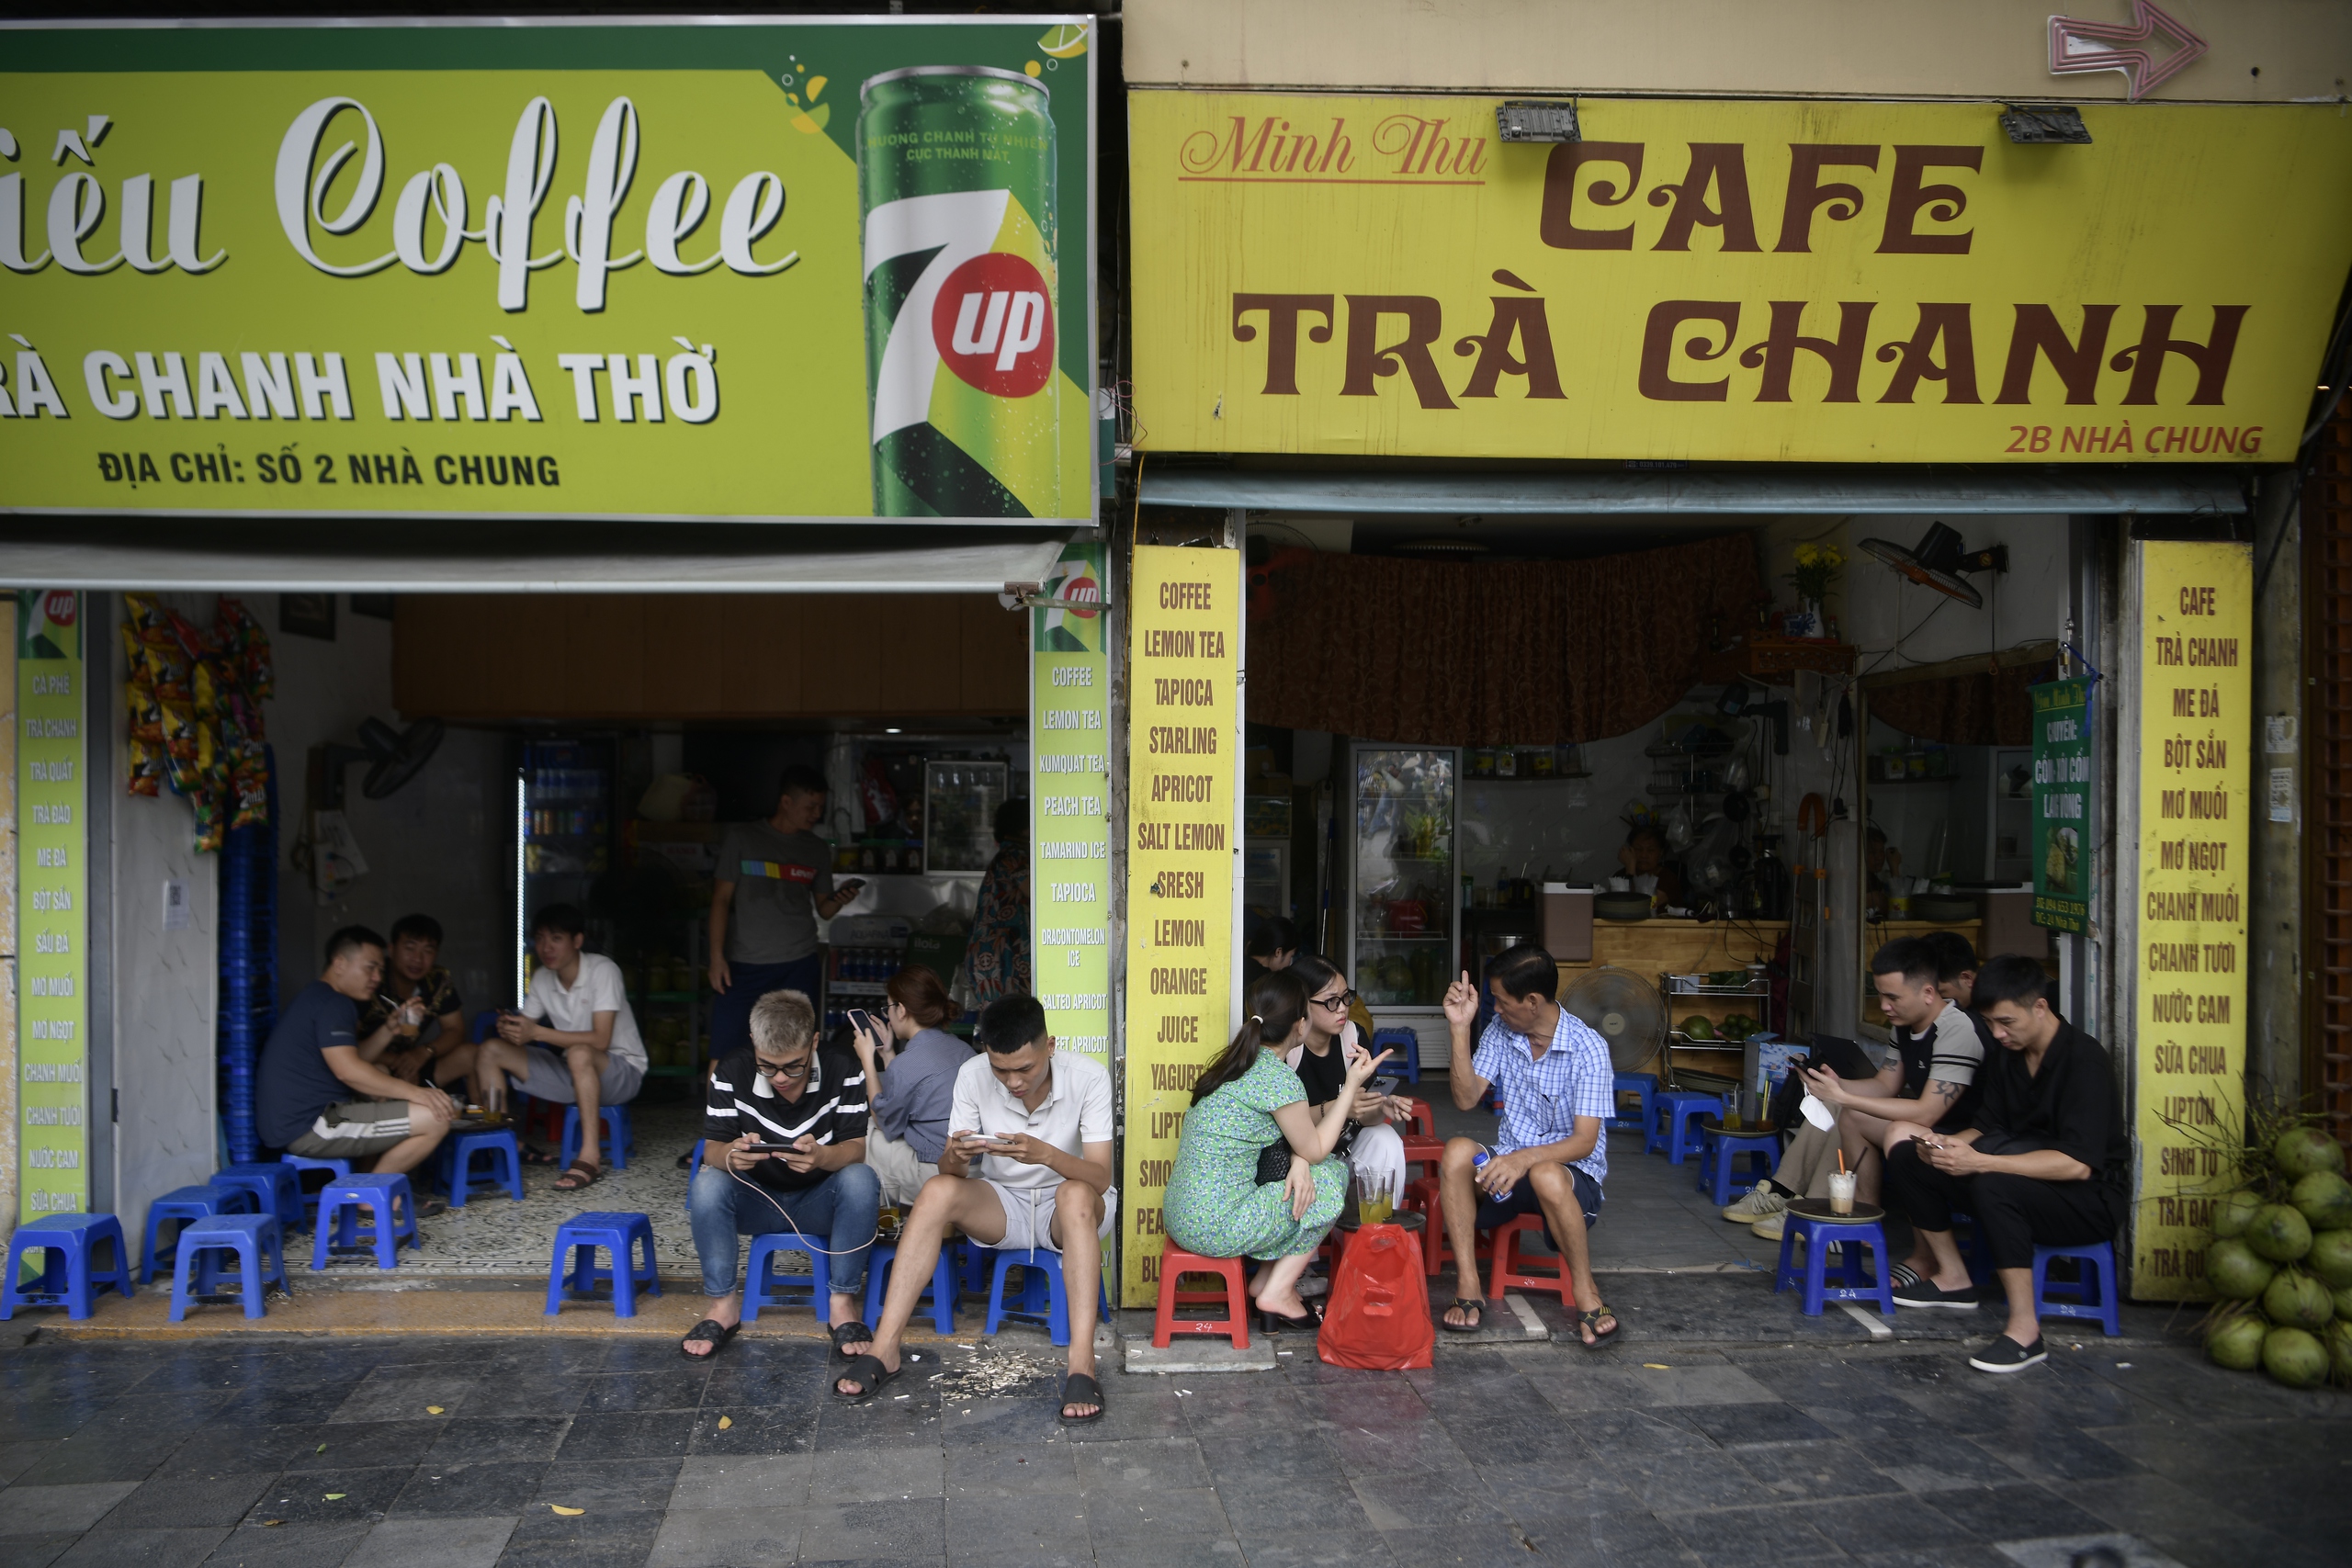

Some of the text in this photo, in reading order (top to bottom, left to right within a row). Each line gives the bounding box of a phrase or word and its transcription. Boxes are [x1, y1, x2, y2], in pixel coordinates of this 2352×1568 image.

[923, 130, 975, 143] CHANH
[1180, 114, 1487, 175] Minh Thu
[275, 96, 801, 313] Coffee
[1539, 141, 1984, 254] CAFE
[953, 290, 1046, 371] up
[1232, 267, 2252, 410] TRÀ CHANH
[83, 350, 355, 422] CHANH
[376, 334, 541, 423] NHÀ
[559, 335, 719, 424] THỜ
[2005, 418, 2264, 456] 2B NHÀ CHUNG
[97, 442, 560, 489] ĐỊA CHỈ: SỐ 2 NHÀ CHUNG
[1159, 581, 1211, 610] COFFEE
[2180, 586, 2215, 615] CAFE
[1144, 629, 1225, 659] LEMON TEA
[2156, 631, 2238, 667] TRÀ CHANH
[32, 672, 71, 694] CÀ PHÊ
[1052, 667, 1092, 686] COFFEE
[1155, 678, 1214, 706] TAPIOCA
[2173, 682, 2220, 717] ME ĐÁ
[26, 715, 77, 738] TRÀ CHANH
[1043, 710, 1102, 729] LEMON TEA
[1149, 726, 1216, 754] STARLING
[2165, 733, 2192, 774] BỘT
[2196, 728, 2227, 769] SẮN
[29, 758, 48, 781] TRÀ
[1039, 754, 1105, 774] KUMQUAT TEA
[2069, 747, 2089, 783] CỐM
[1151, 774, 1213, 803] APRICOT
[2162, 781, 2228, 819] MƠ MUỐI
[32, 801, 71, 824] TRÀ ĐÀO
[1045, 796, 1102, 816] PEACH TEA
[1040, 841, 1106, 859] TAMARIND ICE
[1137, 822, 1225, 852] SALT LEMON
[37, 843, 67, 867] ME ĐÁ
[2161, 838, 2227, 877] MƠ NGỌT
[1051, 883, 1096, 902] TAPIOCA
[1157, 871, 1204, 899] SRESH
[33, 886, 51, 913] BỘT
[2147, 883, 2239, 922] CHANH MUỐI
[56, 930, 69, 953] ĐÁ
[1042, 928, 1105, 945] DRACONTOMELON
[1154, 919, 1204, 947] LEMON
[1068, 950, 1080, 967] ICE
[2149, 941, 2235, 973] CHANH TƯƠI
[1150, 967, 1207, 995] ORANGE
[1042, 994, 1107, 1010] SALTED APRICOT
[2153, 988, 2230, 1024] NƯỚC CAM
[50, 1021, 74, 1043] NGỌT
[1157, 1015, 1198, 1043] JUICE
[1069, 1036, 1108, 1053] APRICOT
[2154, 1039, 2227, 1075] SỮA CHUA
[25, 1064, 55, 1083] CHANH
[26, 1106, 57, 1125] CHANH
[2165, 1096, 2215, 1126] LIPTON
[56, 1149, 78, 1169] CAM
[2161, 1145, 2196, 1176] SINH
[51, 1192, 76, 1212] CHUA
[2154, 1243, 2180, 1277] TRÀ
[1839, 1289, 1857, 1299] 24
[2060, 1304, 2076, 1316] 24
[1195, 1322, 1213, 1332] 24
